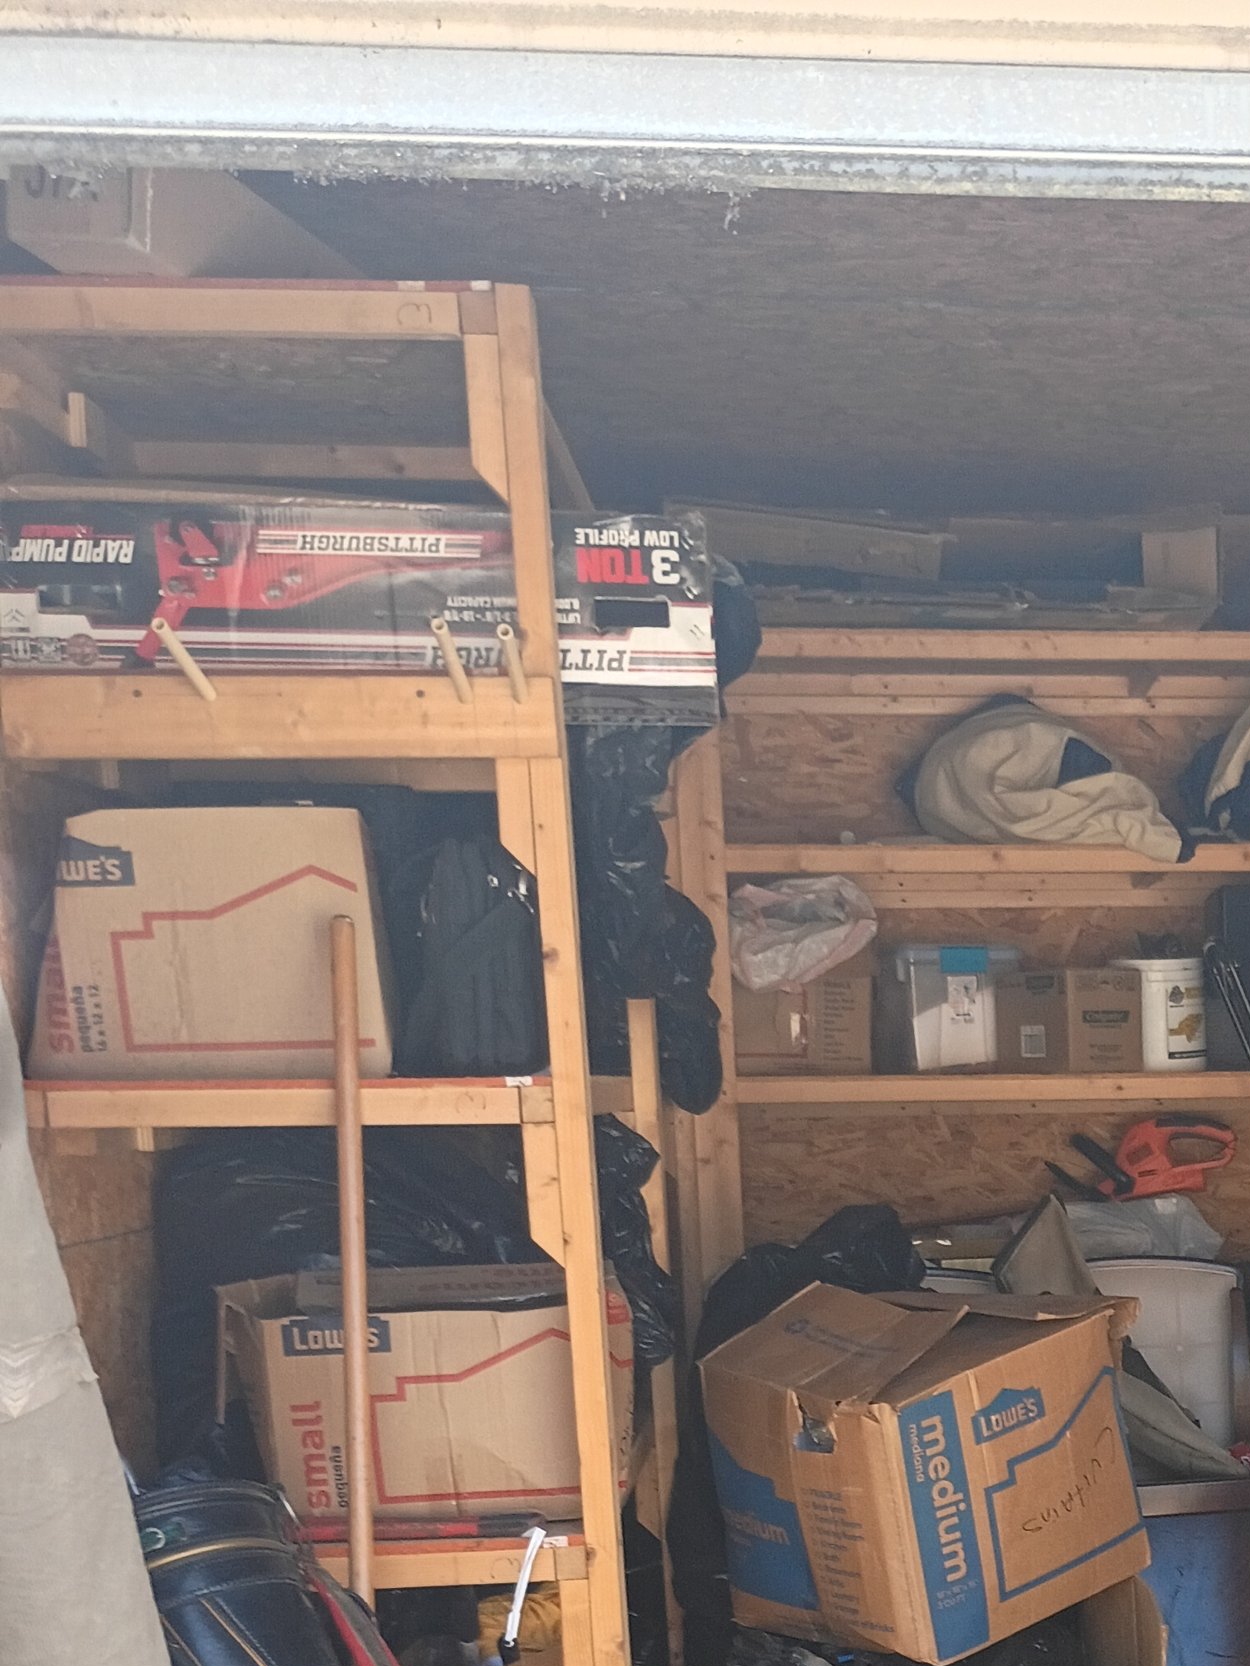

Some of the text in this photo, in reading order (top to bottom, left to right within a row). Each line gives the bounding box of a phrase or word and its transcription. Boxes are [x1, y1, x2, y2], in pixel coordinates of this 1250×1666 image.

[11, 537, 135, 563] RAPID PUMP
[298, 533, 444, 555] PITTSBURGH
[574, 527, 679, 548] LOW PROFILE
[575, 547, 680, 585] 3 TON
[980, 1398, 1038, 1438] LOWE'S
[289, 1401, 330, 1509] small
[908, 1424, 926, 1483] mediana
[921, 1415, 968, 1583] medium
